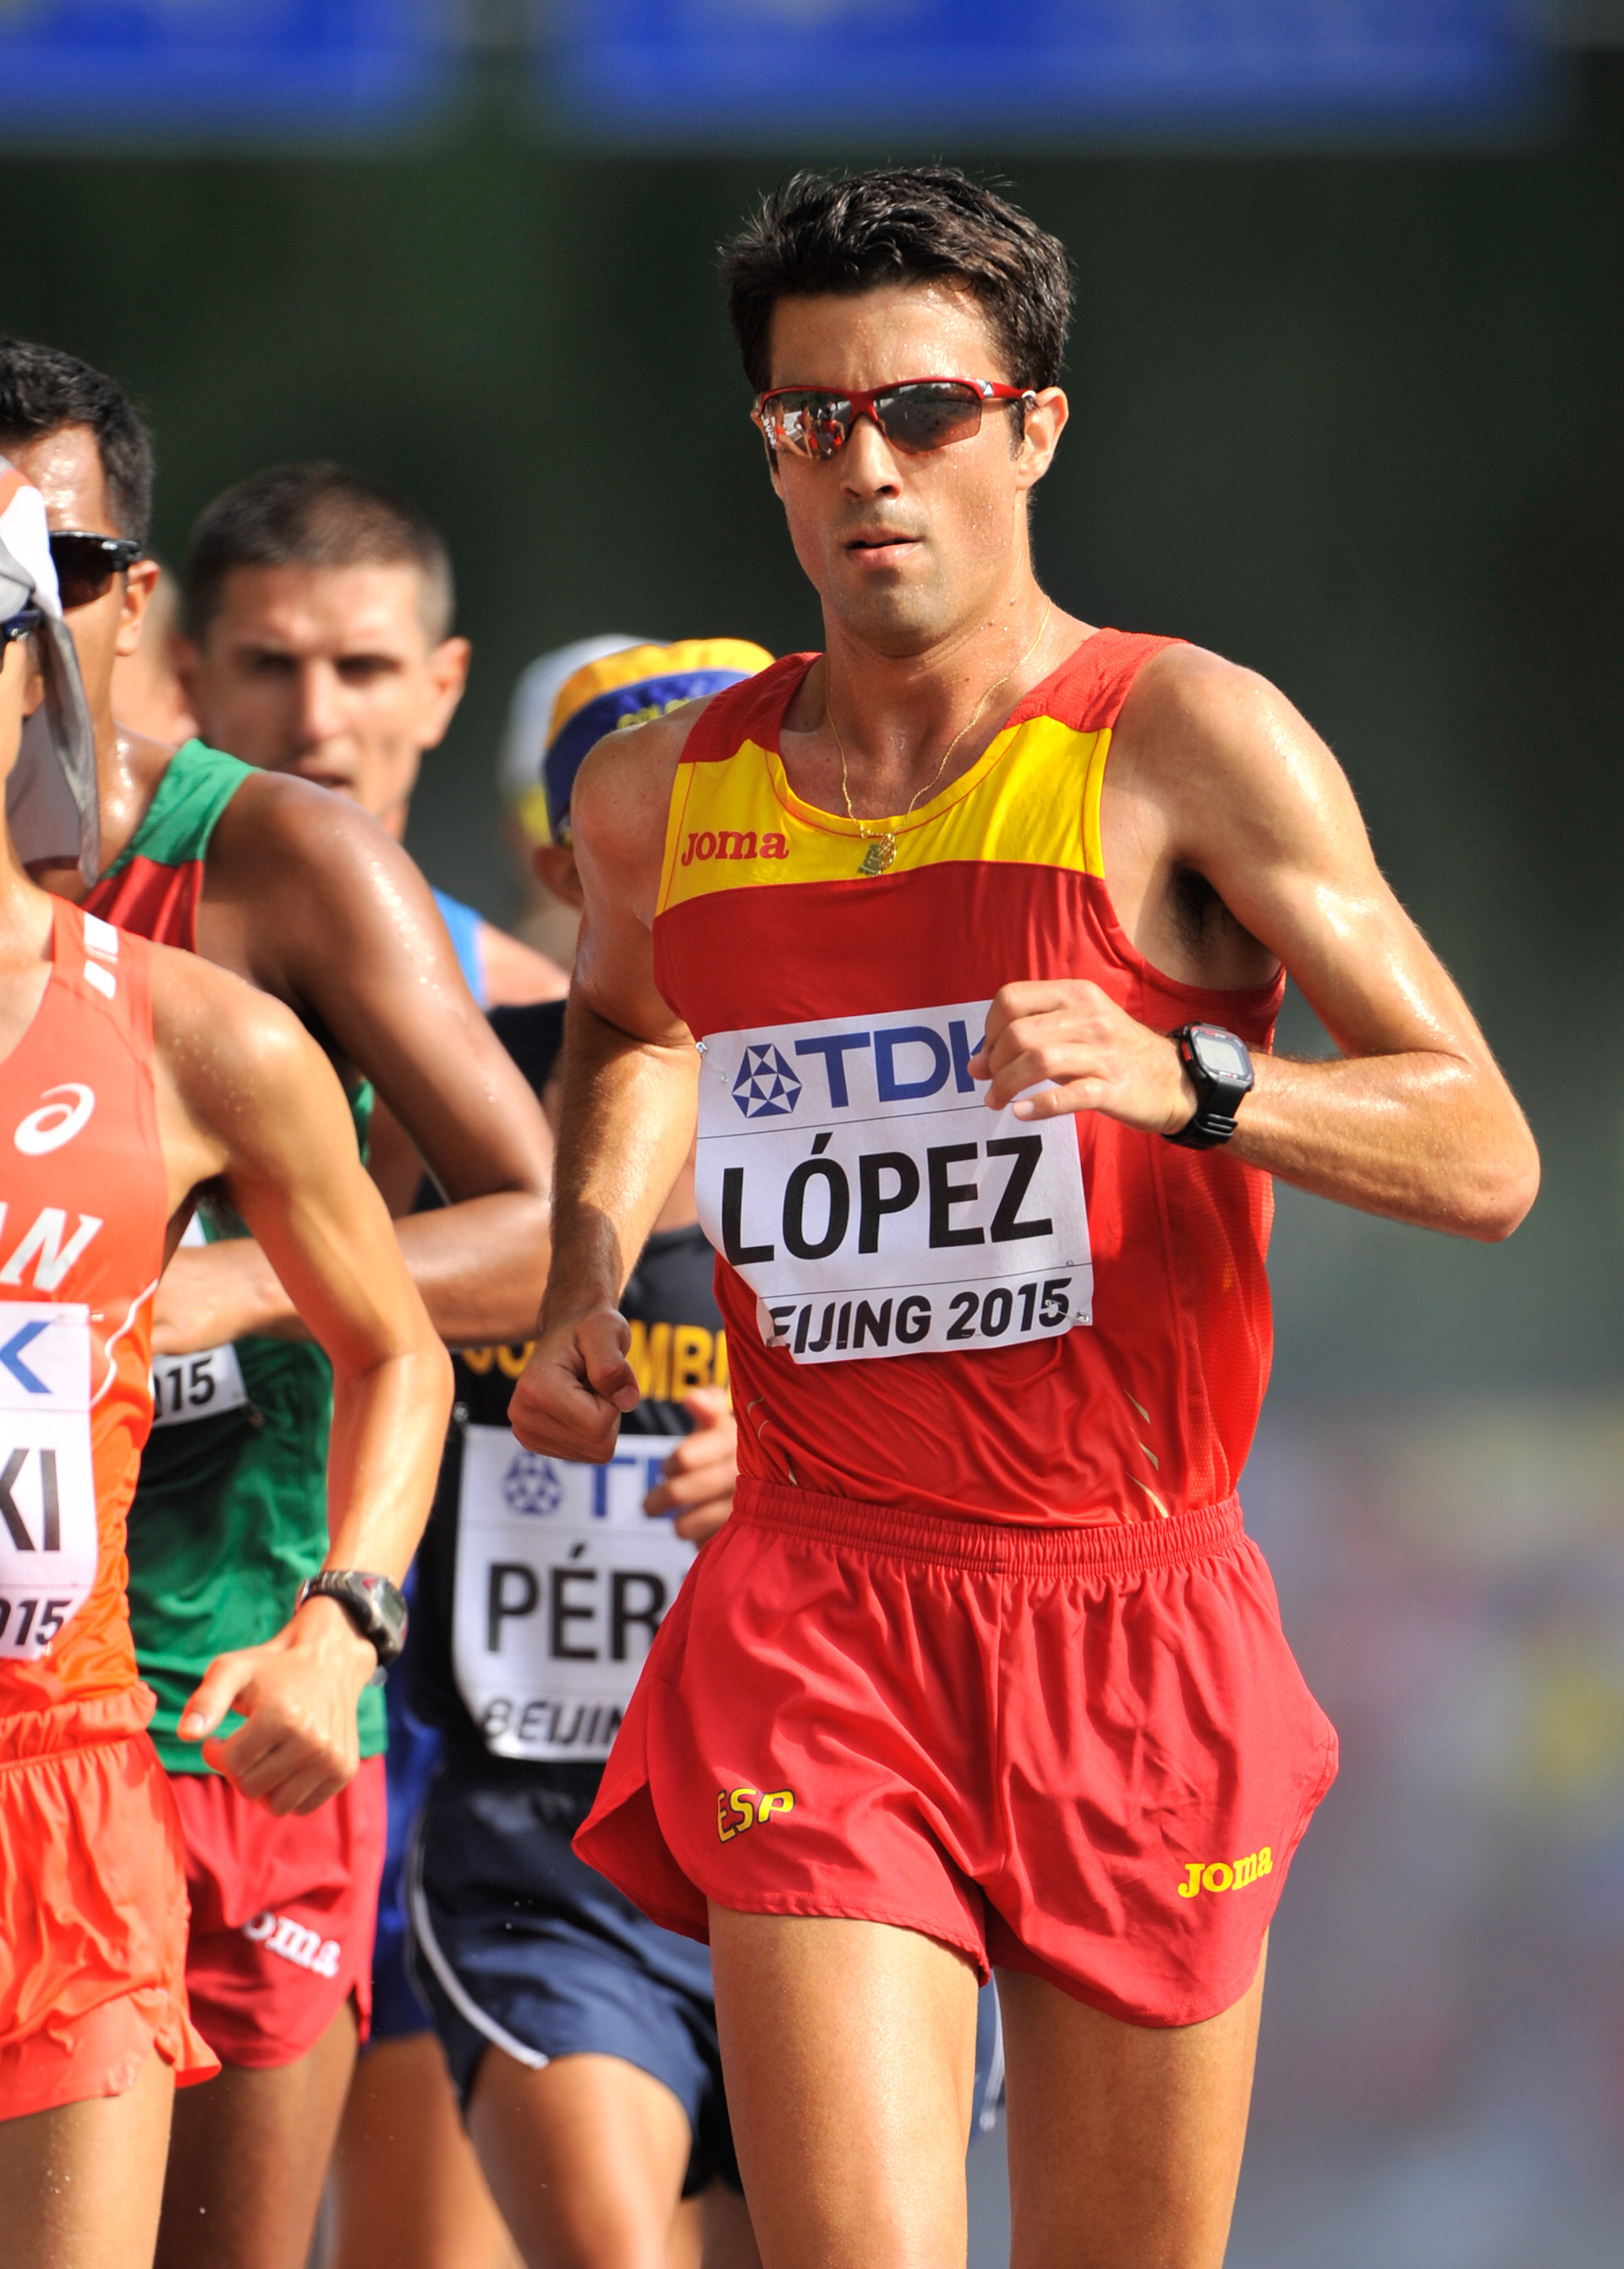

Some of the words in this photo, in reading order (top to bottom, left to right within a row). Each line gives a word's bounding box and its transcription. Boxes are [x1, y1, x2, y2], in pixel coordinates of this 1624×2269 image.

[721, 1132, 1054, 1267] LÓPEZ
[769, 1295, 932, 1354] EIJING
[946, 1277, 1073, 1341] 2015
[152, 1357, 217, 1421] 15
[487, 1541, 670, 1663] PÉR
[717, 1786, 795, 1844] ESP
[241, 1909, 341, 1979] oma
